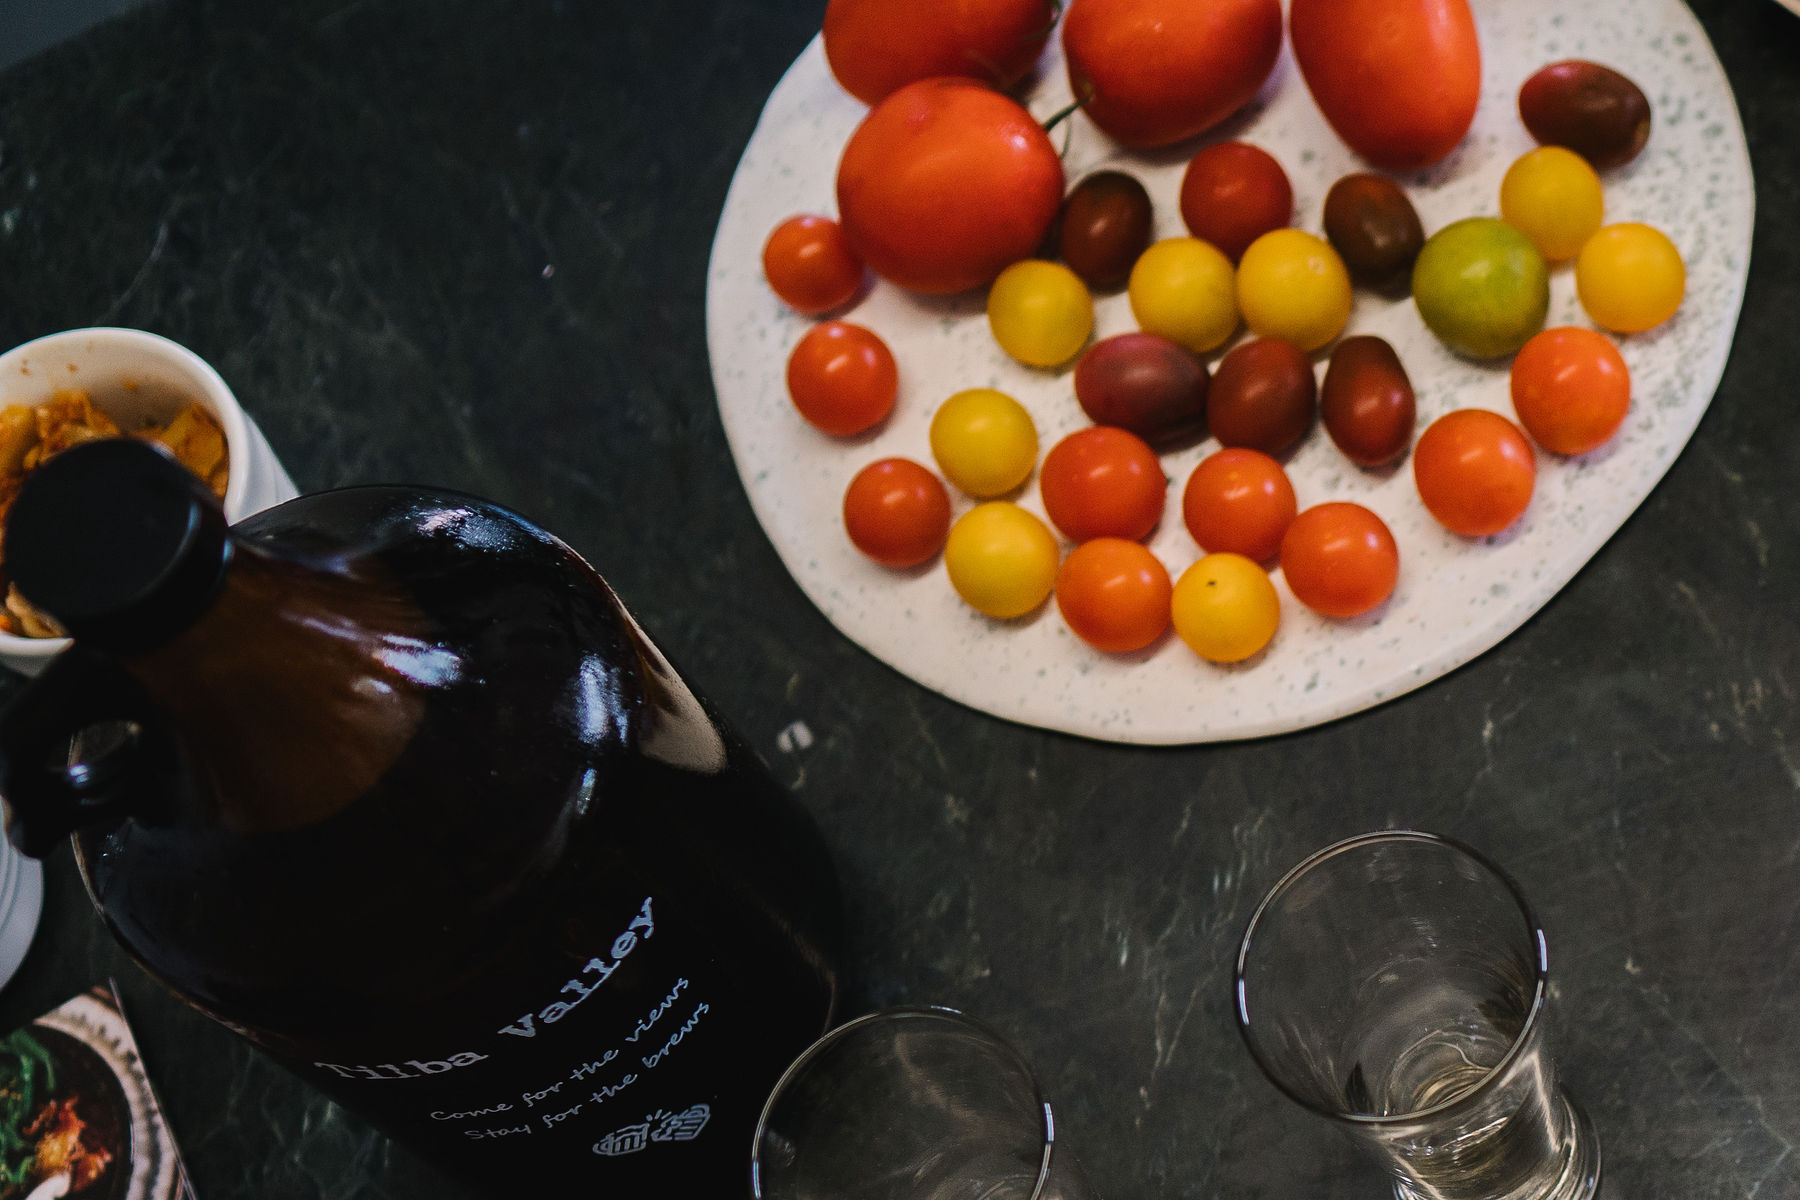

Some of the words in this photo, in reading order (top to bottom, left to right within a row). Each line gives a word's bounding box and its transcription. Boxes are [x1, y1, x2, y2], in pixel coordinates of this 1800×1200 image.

[315, 1049, 489, 1081] Tilba
[497, 896, 656, 1038] Valley
[430, 1103, 511, 1122] Come
[521, 1079, 564, 1107] for
[569, 1048, 620, 1089] the
[626, 975, 690, 1045] views
[464, 1124, 533, 1143] Stay
[542, 1099, 585, 1130] for
[589, 1072, 638, 1104] the
[642, 1001, 711, 1070] brews
